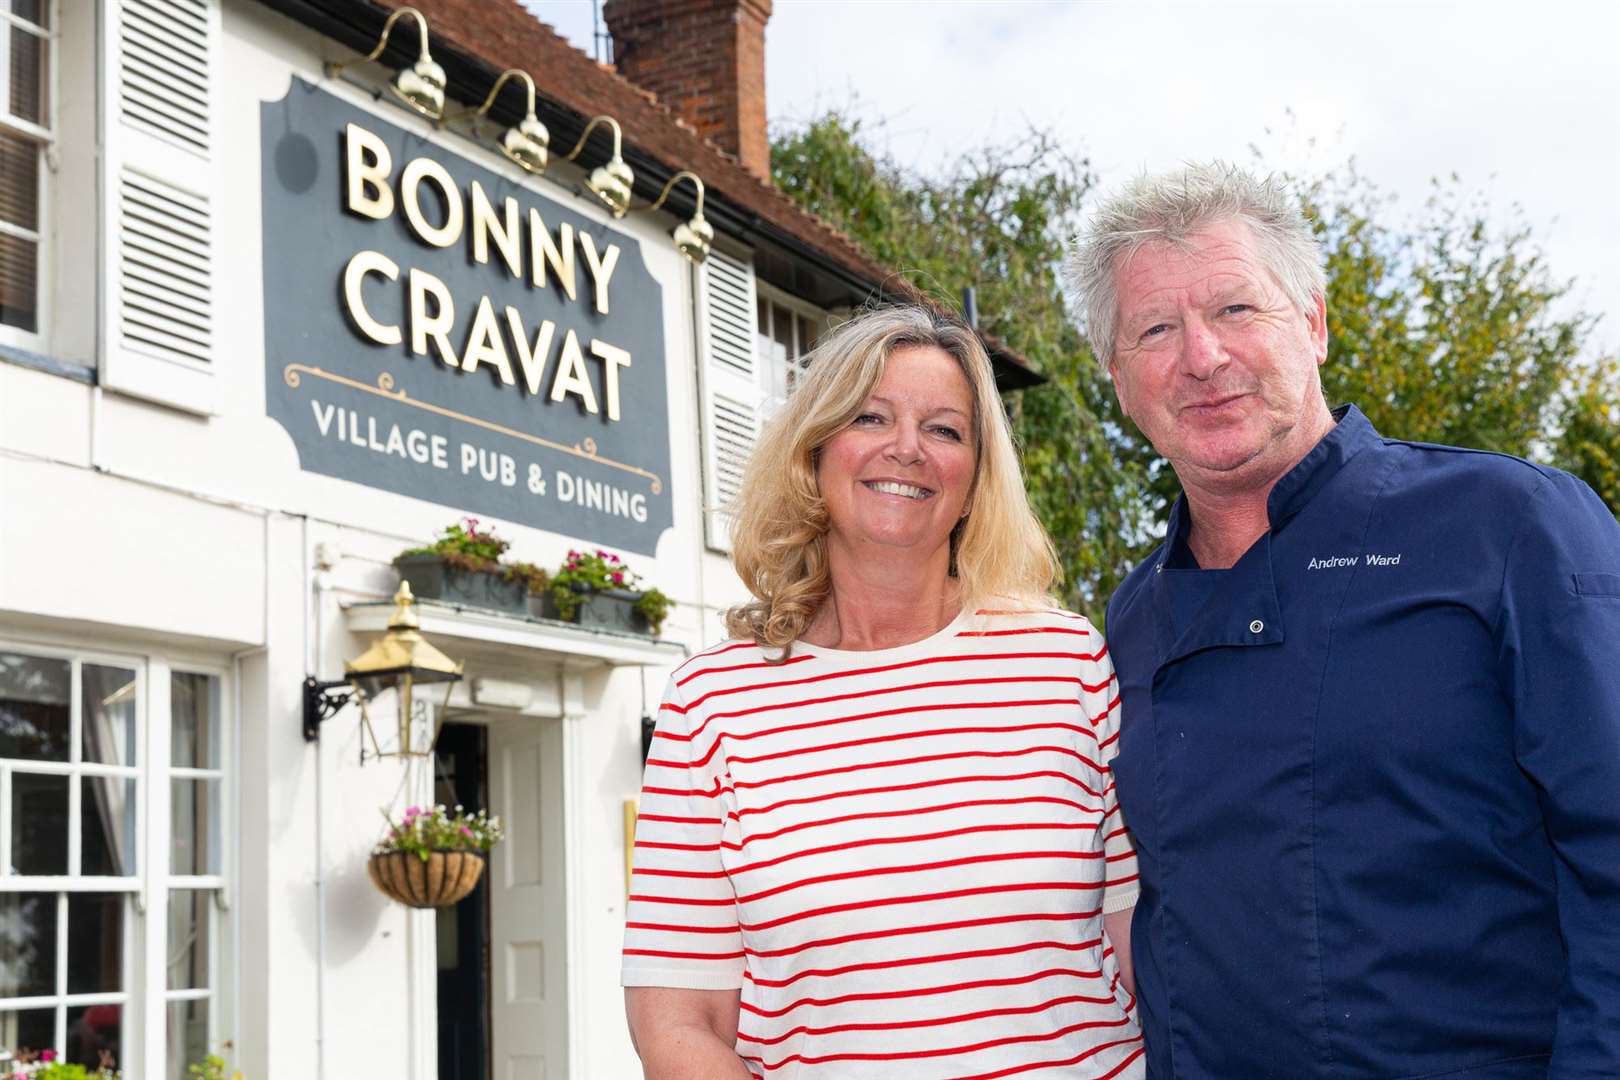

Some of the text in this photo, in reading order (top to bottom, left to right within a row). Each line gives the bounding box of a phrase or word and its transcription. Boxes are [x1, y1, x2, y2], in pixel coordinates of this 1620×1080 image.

[346, 122, 621, 315] BONNY
[343, 250, 632, 422] CRAVAT
[311, 400, 648, 523] VILLAGE PUB & DINING
[1307, 553, 1401, 571] Andrew Ward
